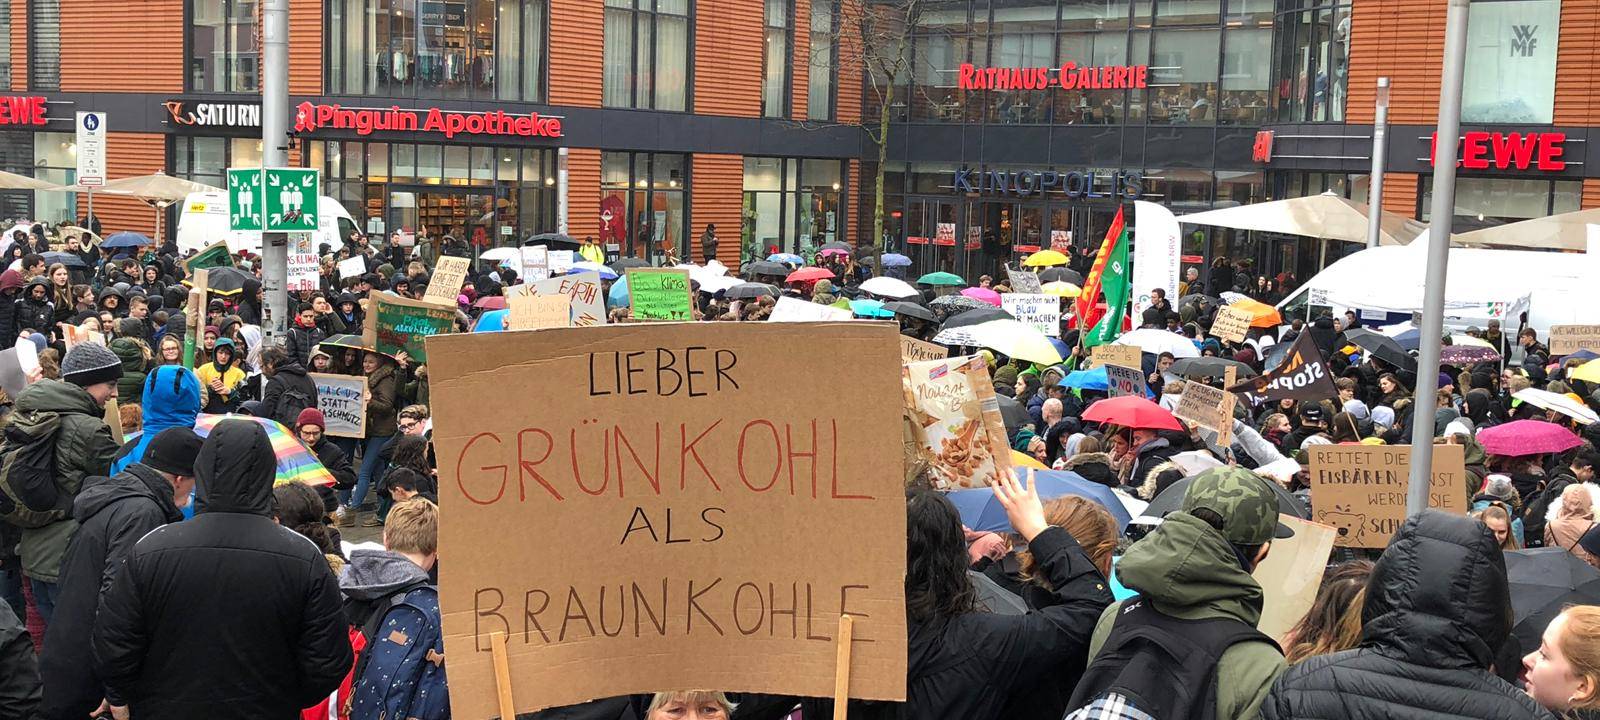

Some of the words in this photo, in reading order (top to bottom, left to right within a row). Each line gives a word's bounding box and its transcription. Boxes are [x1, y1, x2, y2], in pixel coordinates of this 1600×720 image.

[0, 96, 47, 125] EWE
[196, 103, 260, 127] SATURN
[317, 104, 417, 135] Pinguin
[424, 107, 561, 138] Apotheke
[1430, 131, 1566, 170] EWE
[954, 168, 1143, 200] KINOPOLIS
[296, 254, 319, 264] KLIMA
[558, 279, 598, 305] EARTH
[588, 346, 740, 397] LIEBER
[1105, 364, 1130, 379] THERE
[1118, 380, 1132, 392] NO
[322, 398, 348, 409] STATT
[456, 417, 876, 505] GRÜNKOHL
[1317, 452, 1373, 465] RETTET
[1385, 453, 1408, 465] DIE
[1429, 494, 1454, 508] SIE
[620, 507, 726, 545] ALS
[474, 577, 876, 653] BRAUNKOHLE
